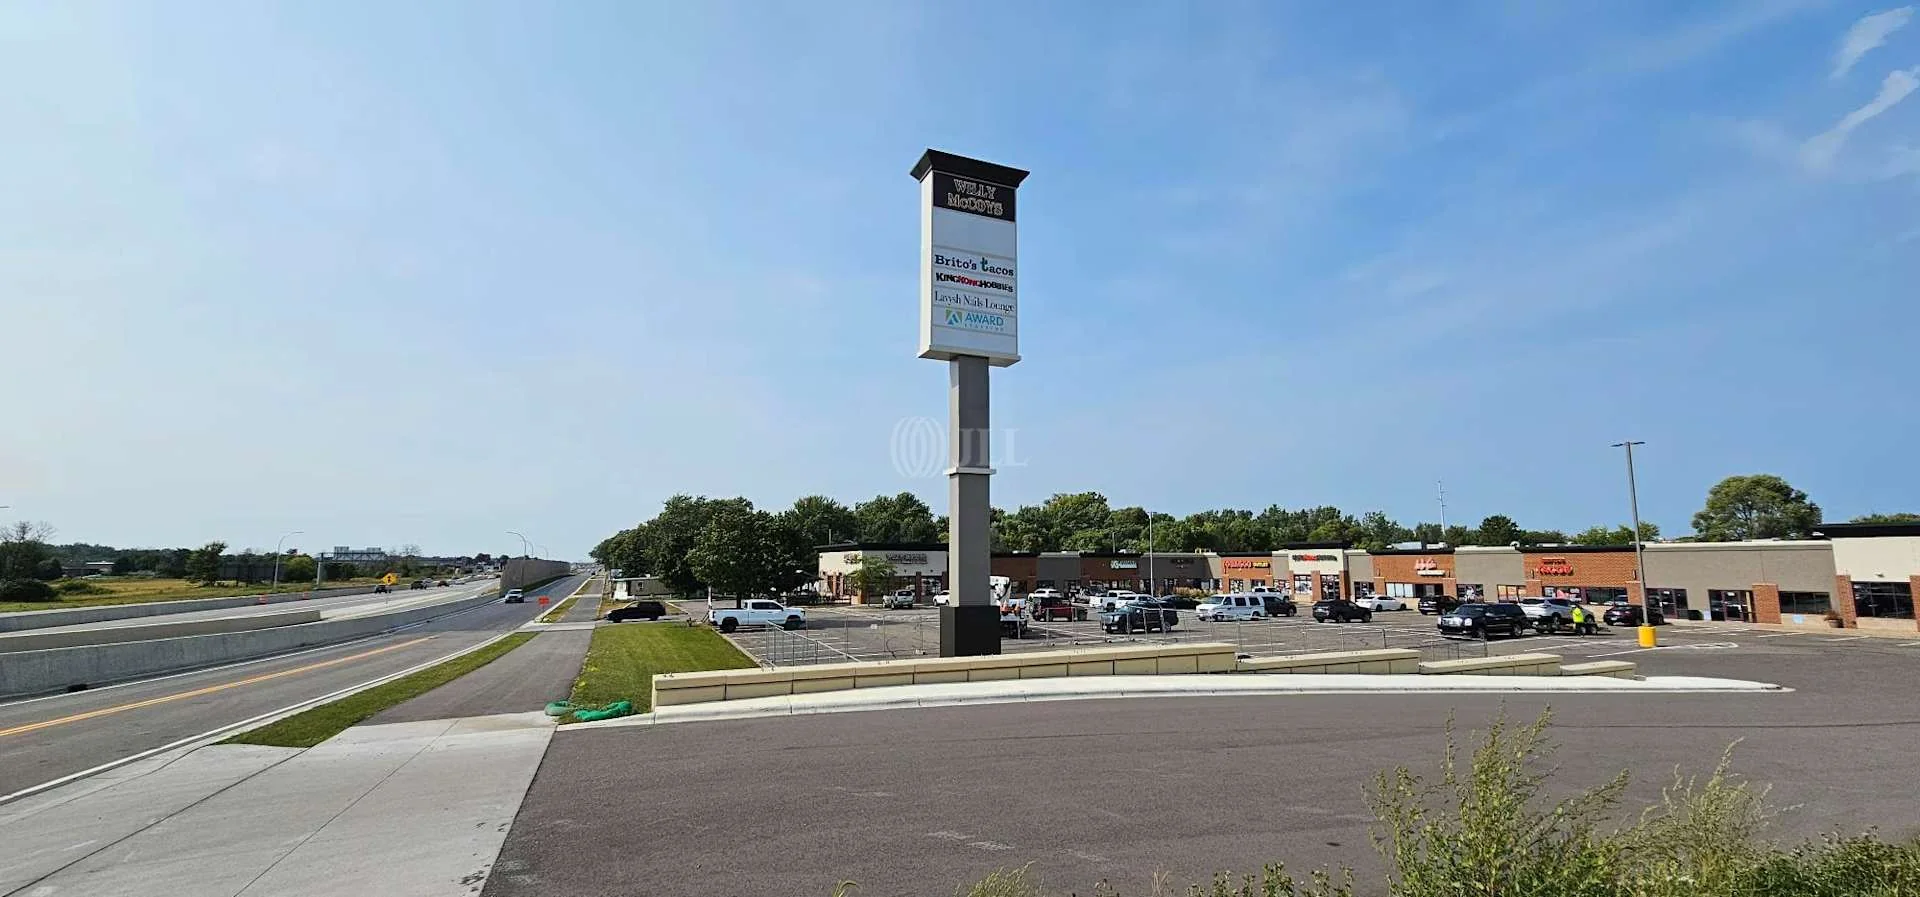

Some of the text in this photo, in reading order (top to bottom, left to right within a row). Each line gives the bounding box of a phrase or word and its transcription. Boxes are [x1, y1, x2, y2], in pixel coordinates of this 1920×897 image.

[953, 178, 997, 200] WILLY
[934, 254, 1014, 277] Brito's tacos
[963, 294, 983, 307] Nails
[985, 298, 1015, 315] Lounge
[964, 312, 1004, 327] AWARD
